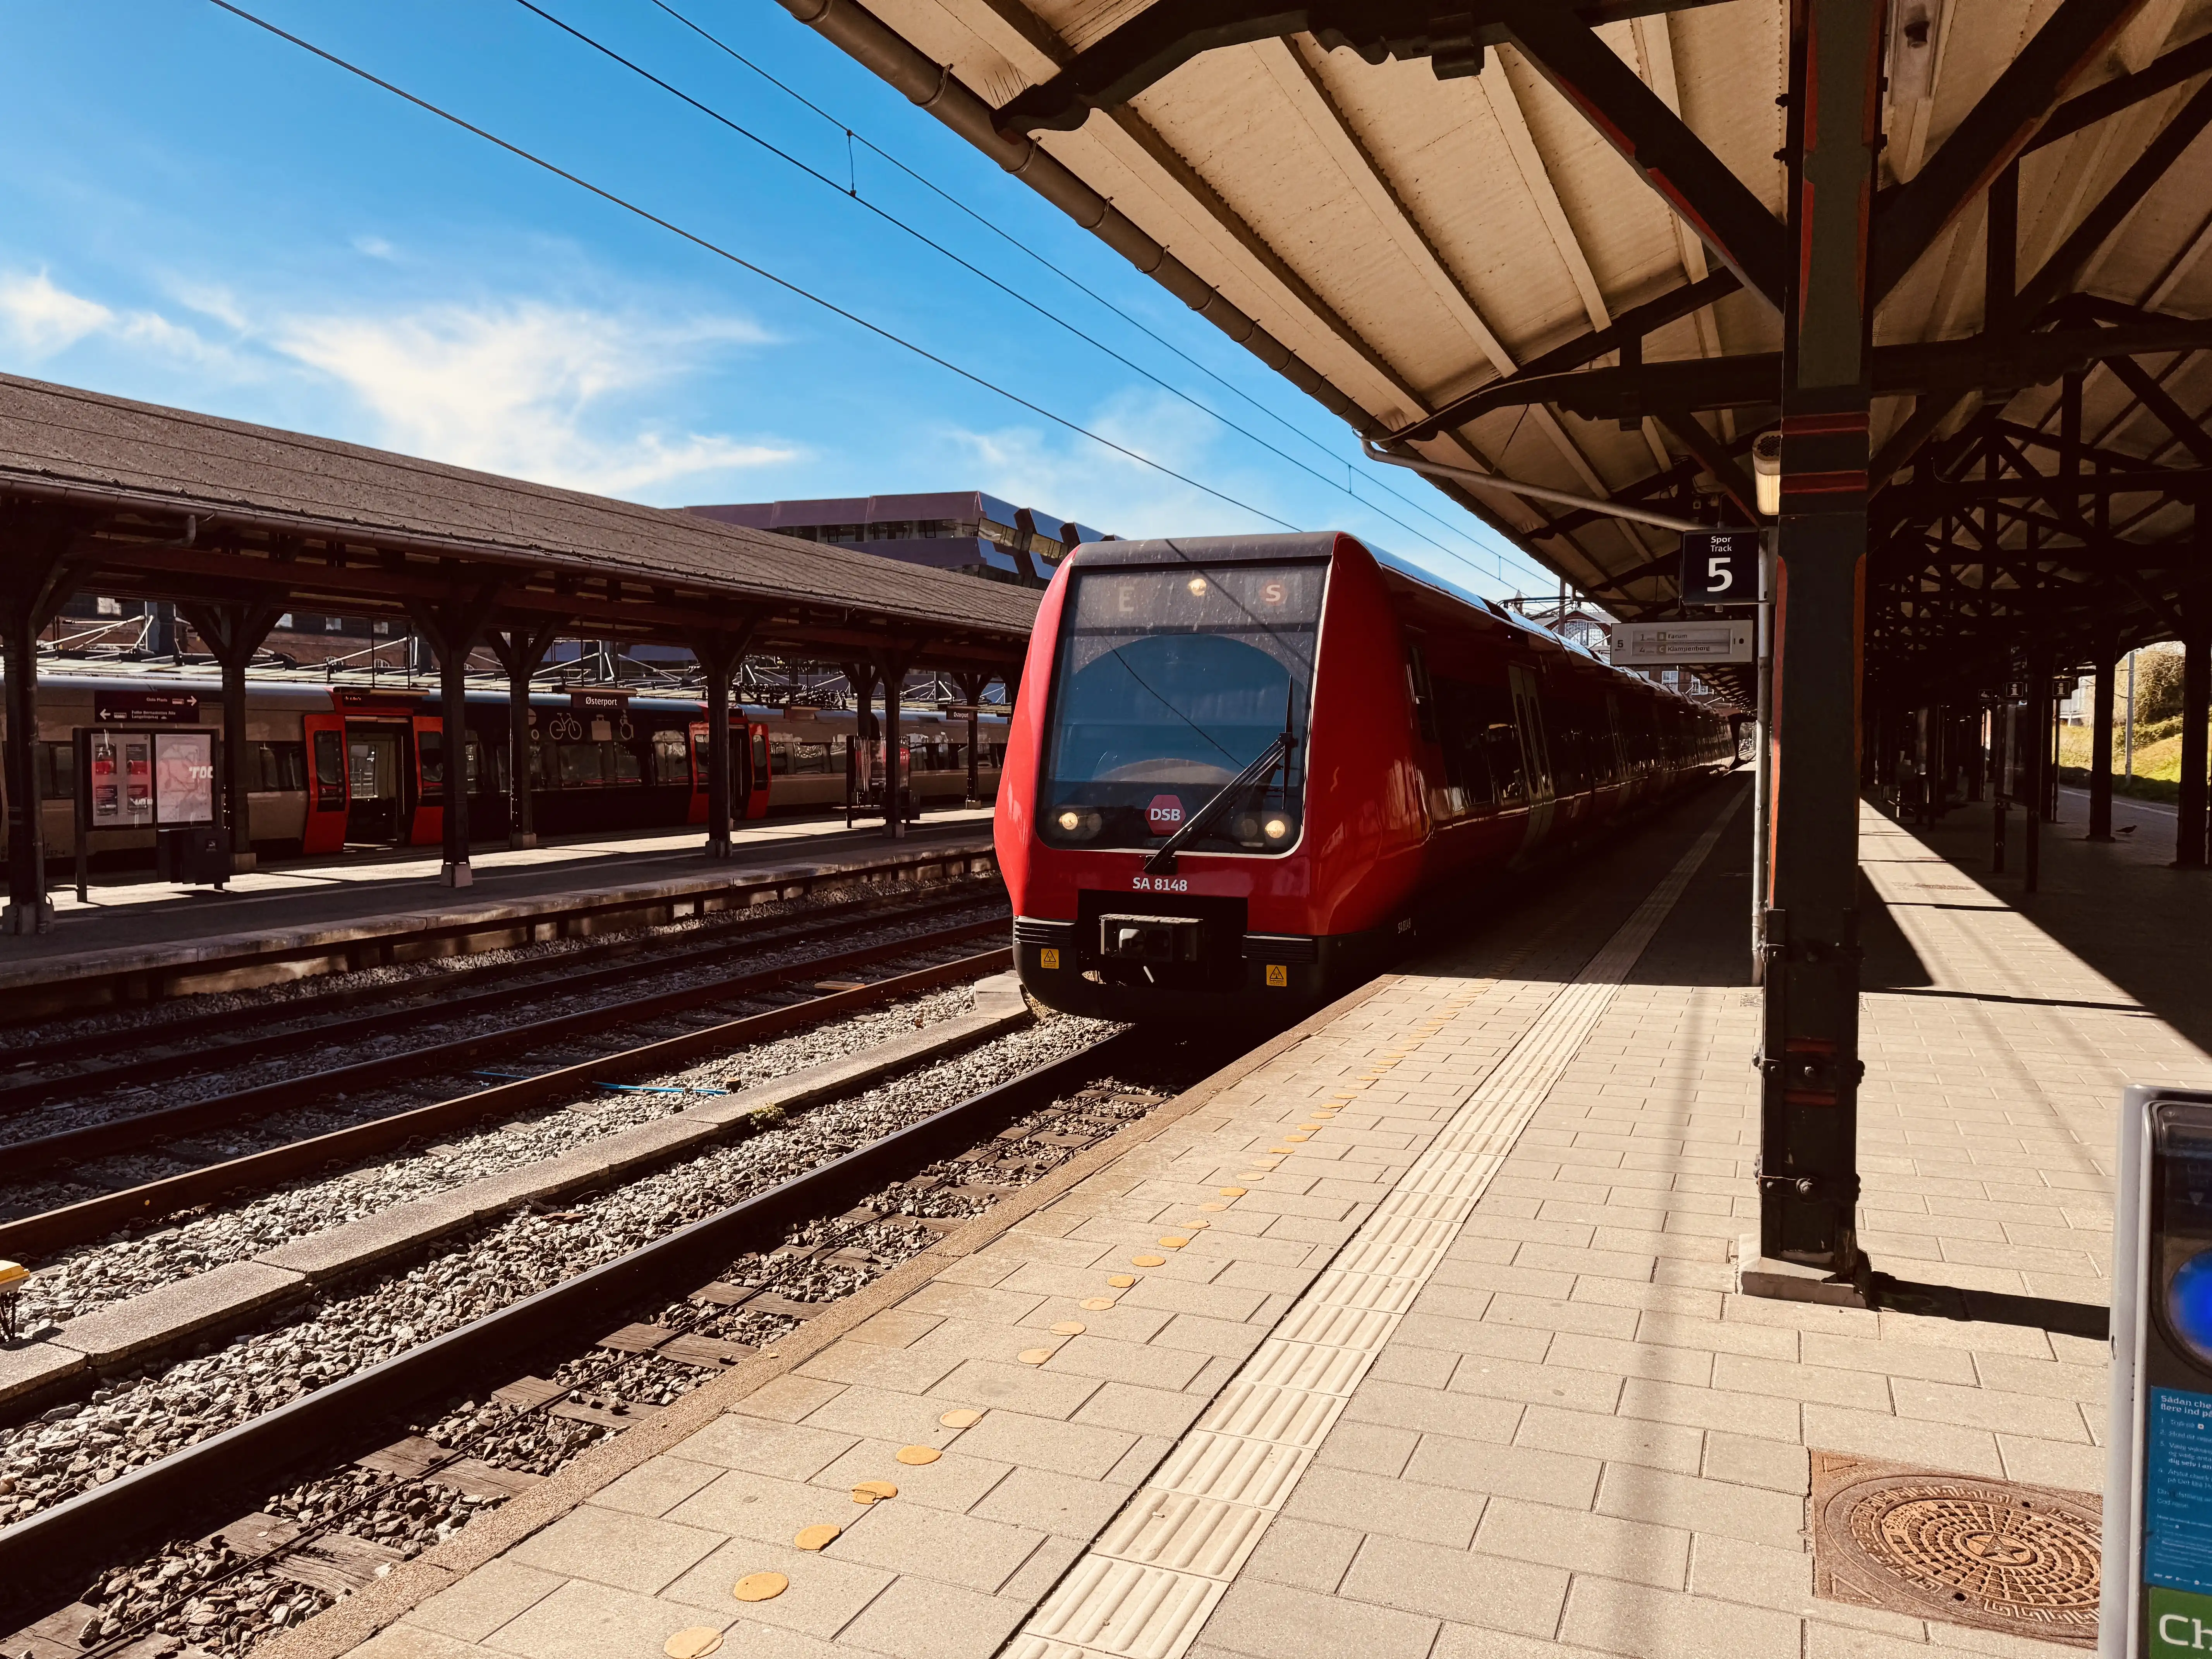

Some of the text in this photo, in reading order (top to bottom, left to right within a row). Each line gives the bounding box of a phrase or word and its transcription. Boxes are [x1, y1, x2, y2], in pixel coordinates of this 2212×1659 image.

[1711, 536, 1731, 544] Spor
[1707, 557, 1733, 592] 5
[1119, 586, 1134, 611] E
[1266, 584, 1281, 602] S
[586, 697, 617, 707] Østerport
[1151, 808, 1180, 821] DSB
[1133, 877, 1188, 892] SA 8148
[2161, 1395, 2192, 1407] Sådan
[2185, 1407, 2200, 1415] ind
